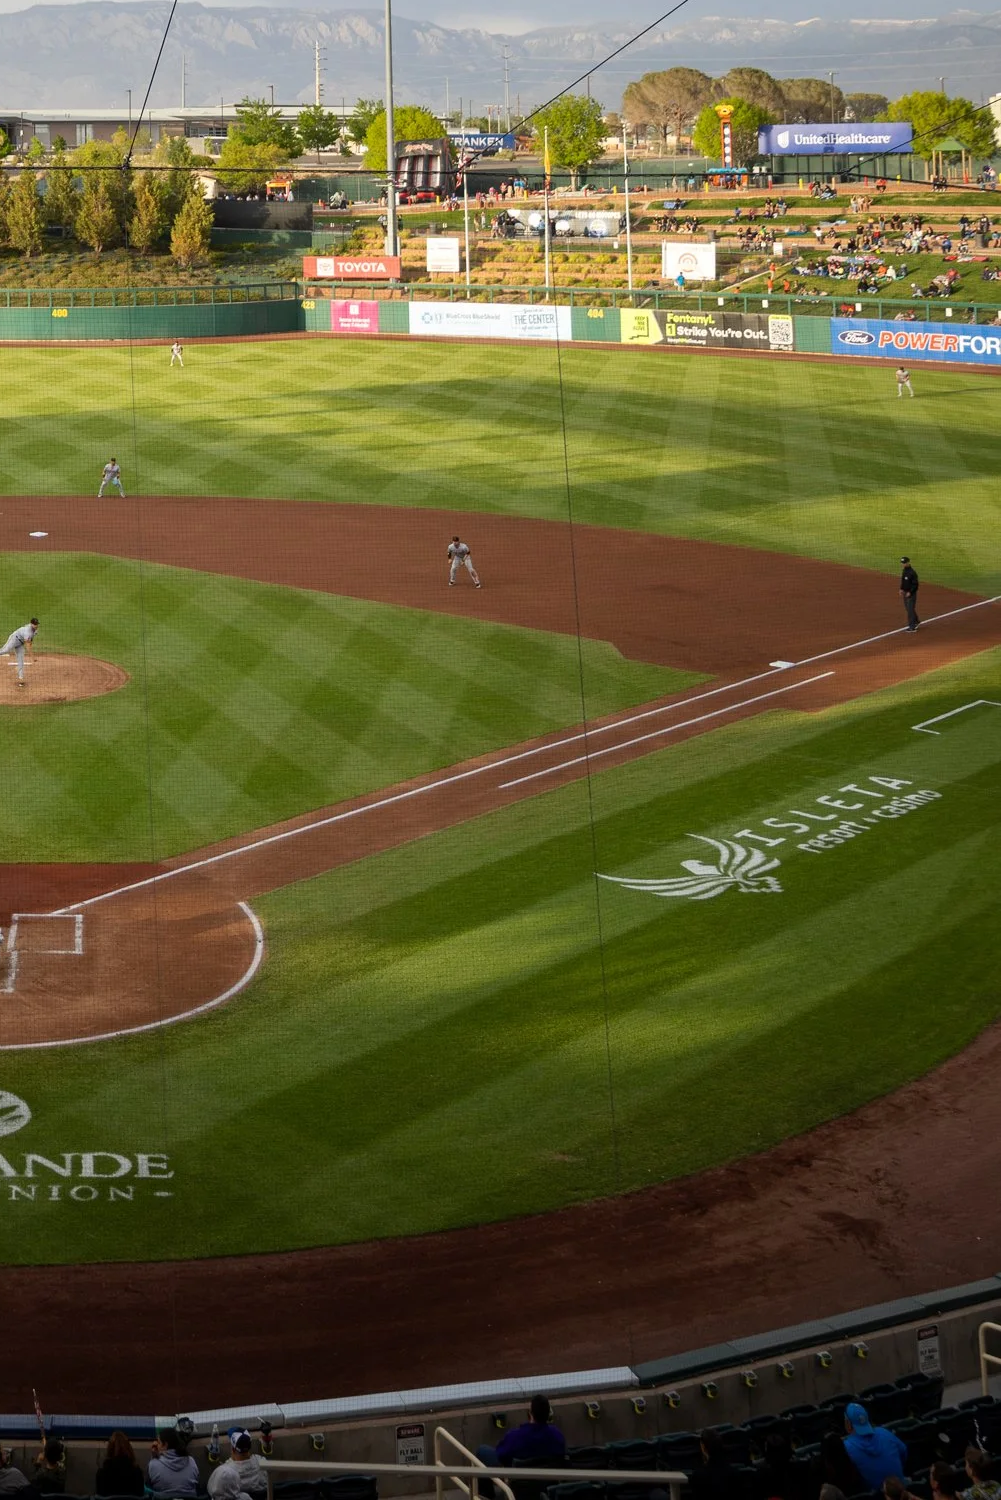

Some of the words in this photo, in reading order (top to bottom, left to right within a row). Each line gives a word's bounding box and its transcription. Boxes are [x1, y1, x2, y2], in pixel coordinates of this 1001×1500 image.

[794, 133, 891, 145] UnitedHealthcare
[337, 262, 386, 272] TOYOTA
[52, 308, 68, 318] 400
[514, 314, 527, 324] THE
[528, 314, 555, 324] CENTER
[667, 313, 715, 326] Fentanyl.
[676, 326, 708, 336] Strike
[709, 327, 742, 338] You're
[744, 329, 768, 339] Out.
[844, 332, 868, 344] Ford
[878, 330, 1001, 355] POWERFOR
[734, 776, 912, 847] ISLETA
[797, 820, 870, 854] resort
[872, 789, 942, 820] casino
